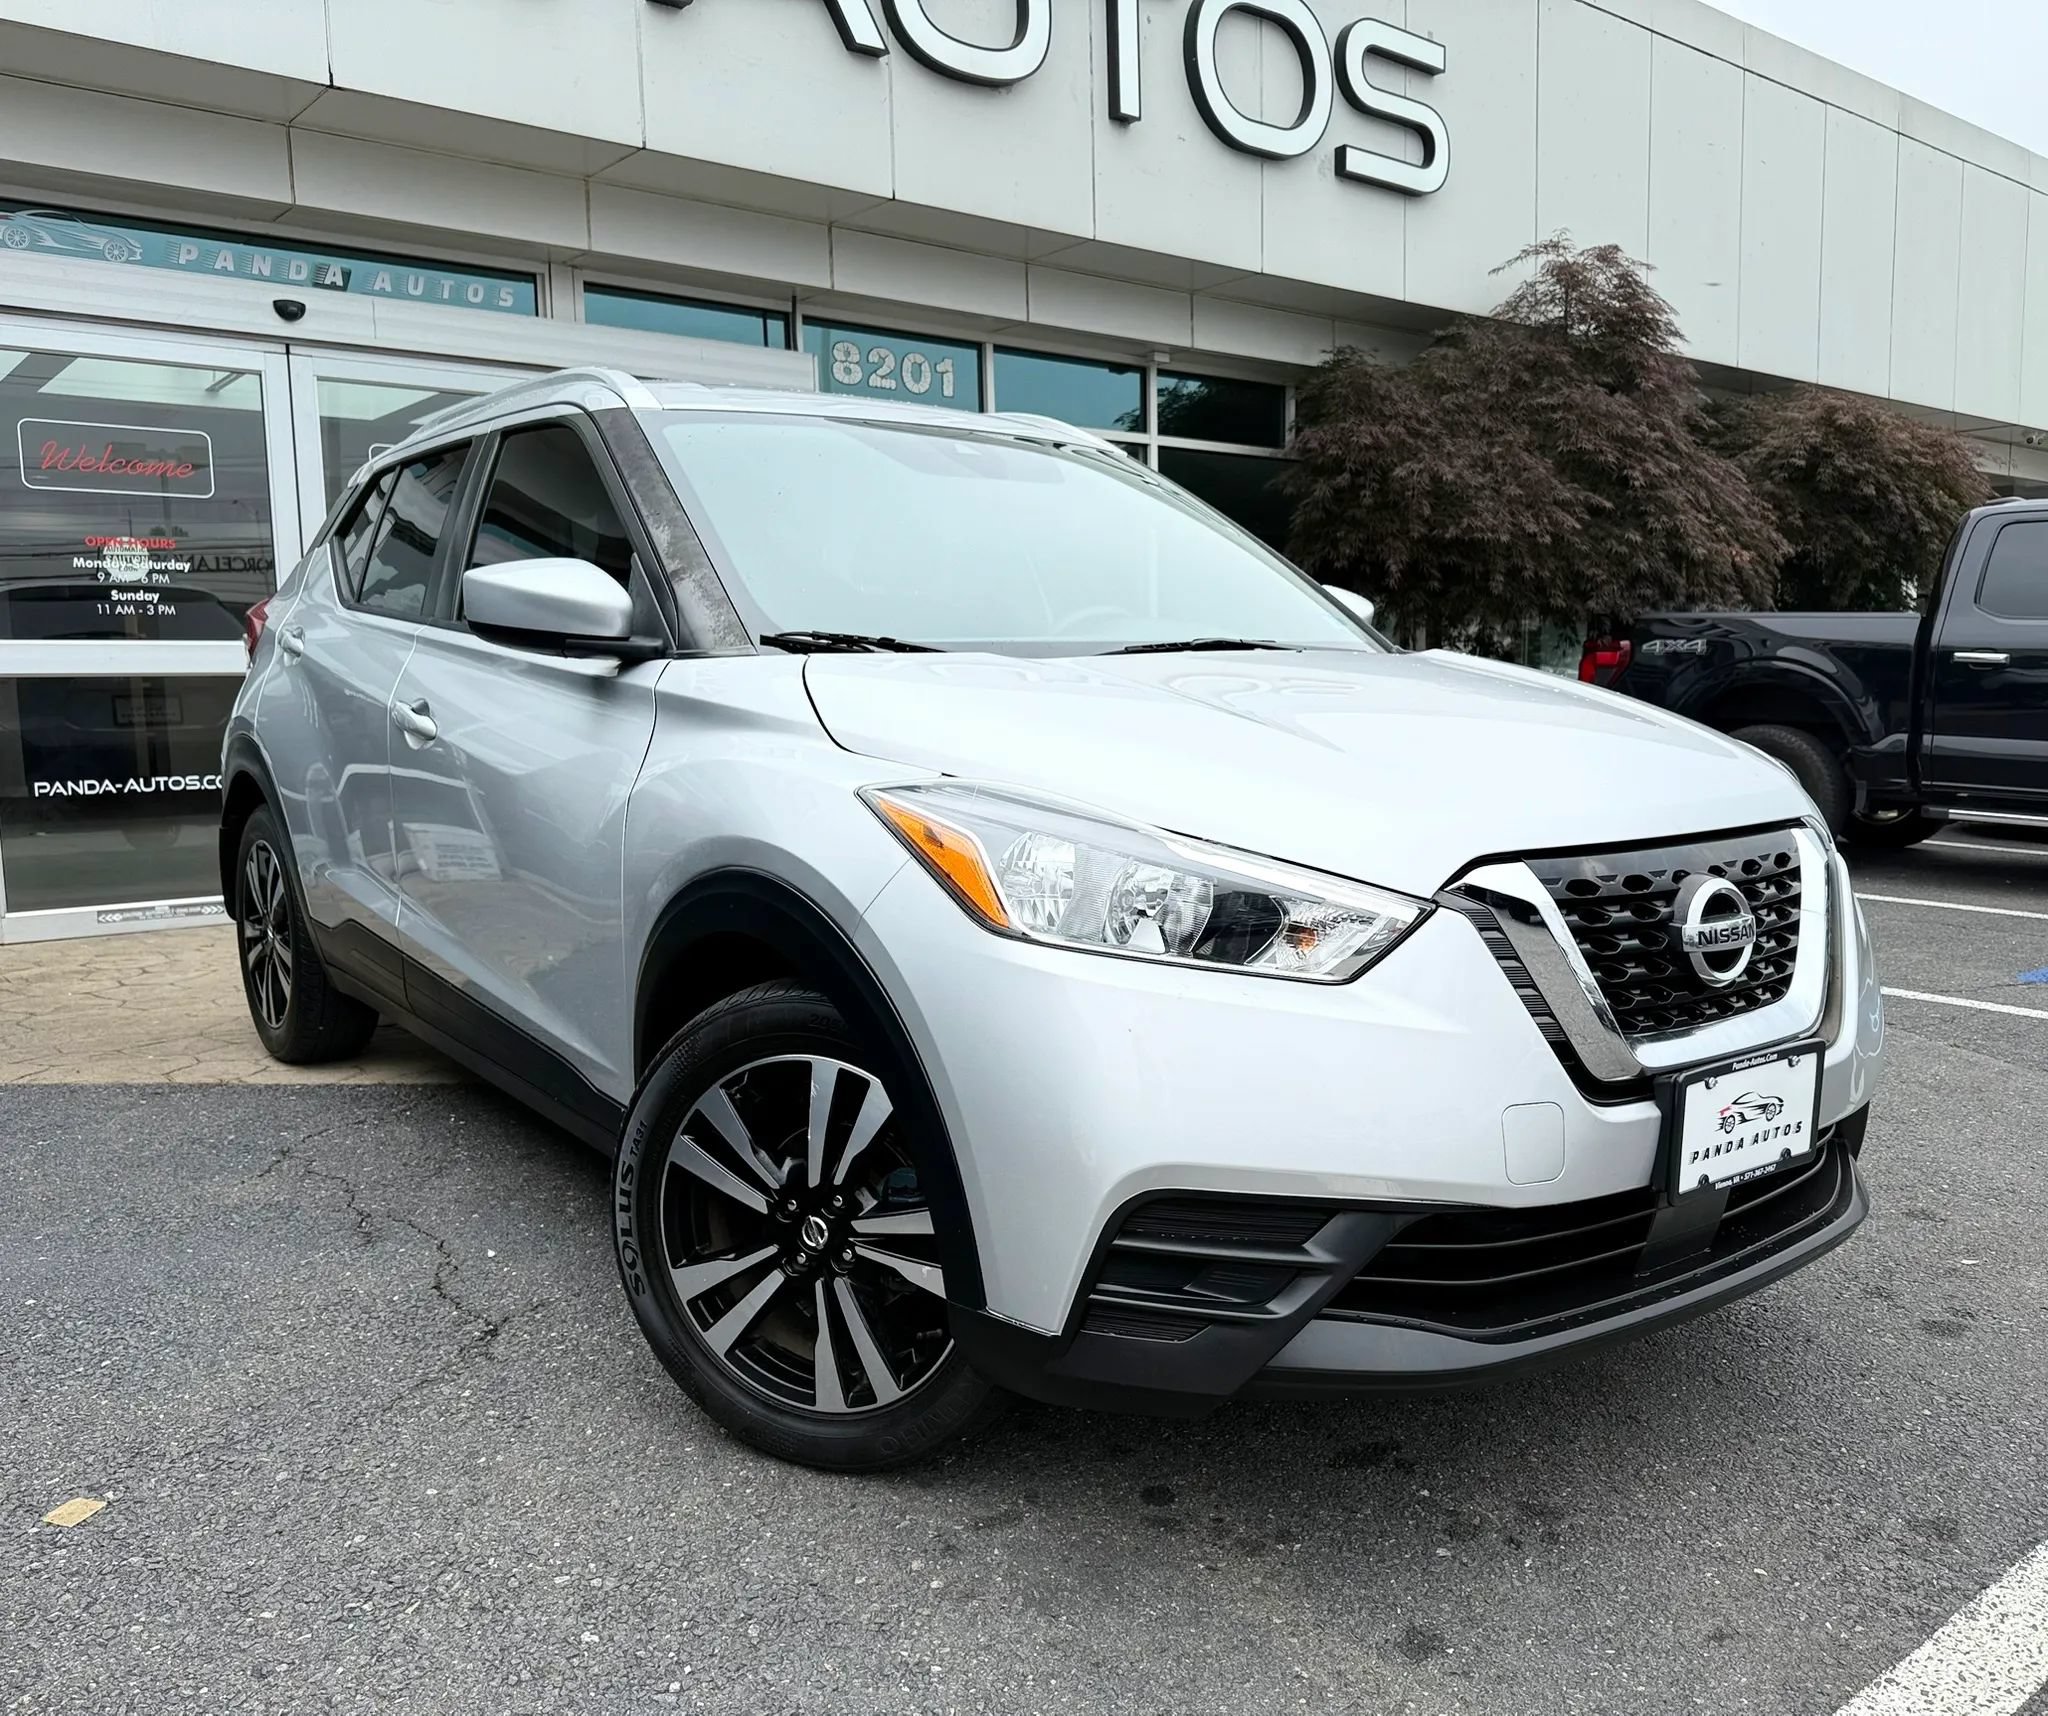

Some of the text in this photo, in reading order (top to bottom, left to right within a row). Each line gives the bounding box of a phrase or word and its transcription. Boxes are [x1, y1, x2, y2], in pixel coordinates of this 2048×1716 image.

[645, 0, 1451, 196] UTOS
[168, 241, 515, 308] PANDA AUTOS
[832, 340, 954, 398] 8201
[40, 440, 195, 478] Welcome
[85, 536, 176, 549] OPEN HOURS
[97, 572, 105, 583] 9
[141, 573, 149, 584] 6
[152, 573, 170, 584] PM
[111, 589, 160, 603] Sunday
[97, 603, 110, 615] 11
[115, 604, 135, 615] AM
[146, 604, 155, 616] 3
[158, 604, 176, 616] PM
[1697, 923, 1755, 946] NISSAN
[1688, 1121, 1803, 1165] PANDA AUTOS
[619, 1120, 649, 1297] SOLUS TA31
